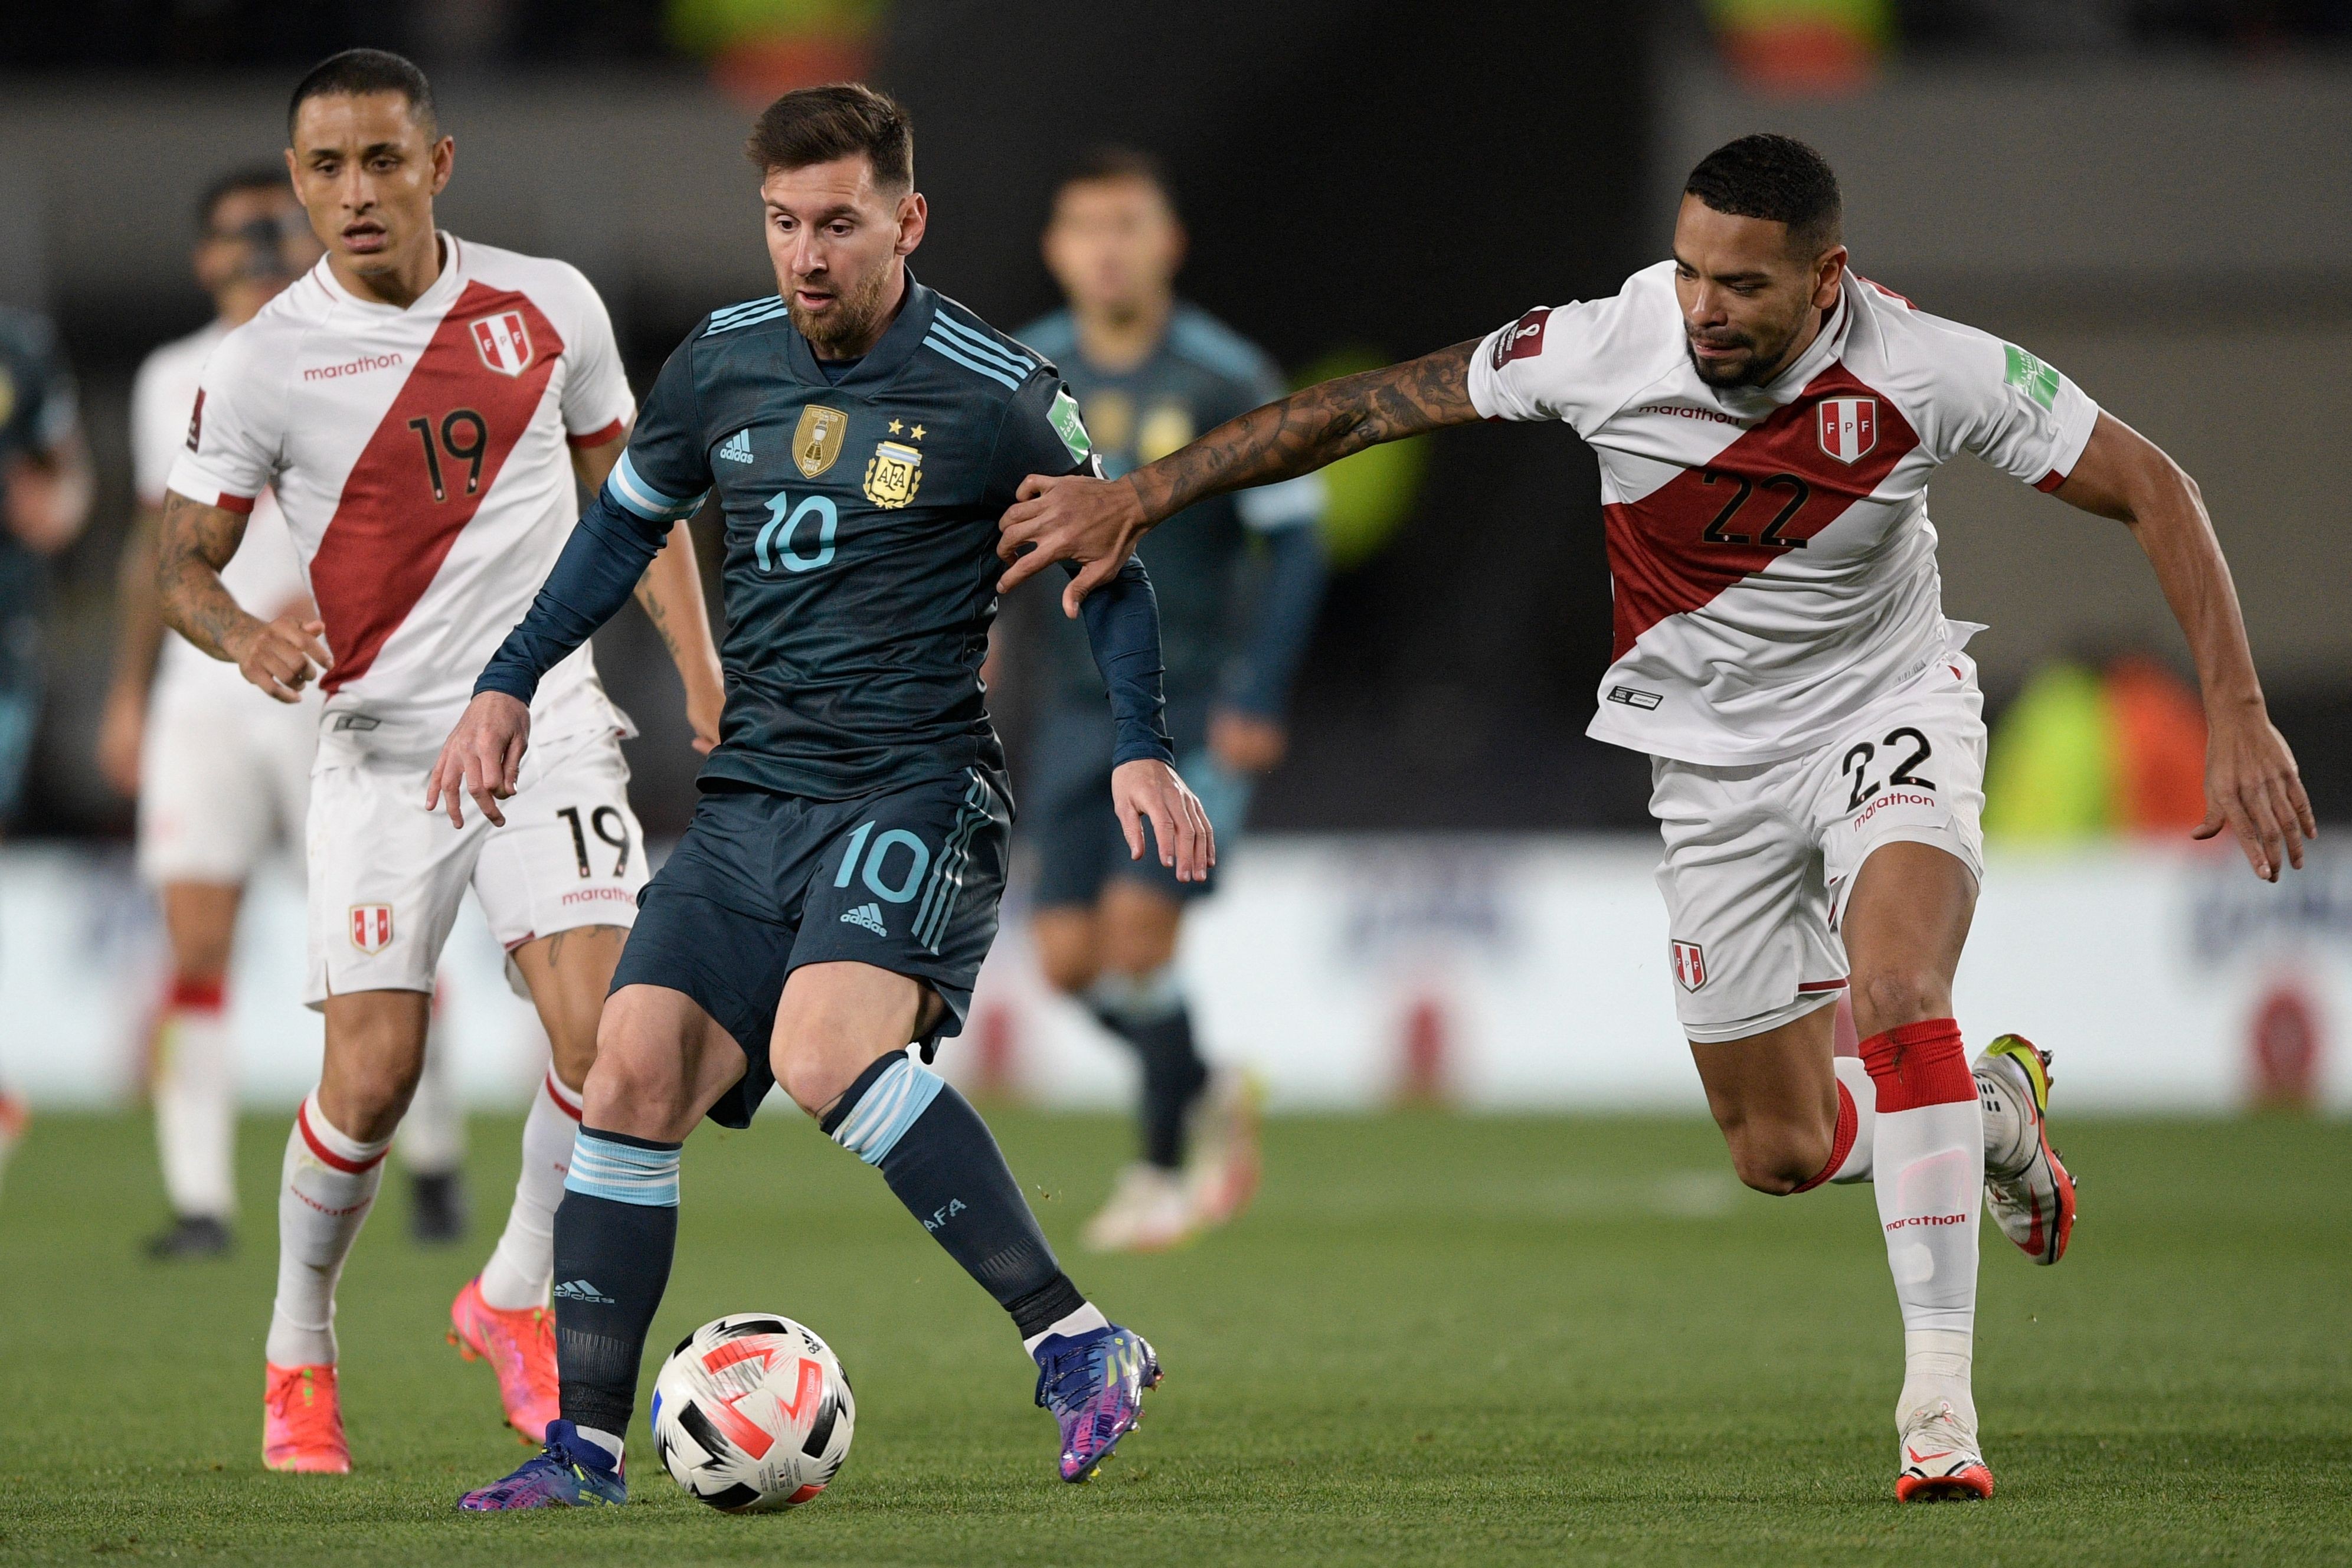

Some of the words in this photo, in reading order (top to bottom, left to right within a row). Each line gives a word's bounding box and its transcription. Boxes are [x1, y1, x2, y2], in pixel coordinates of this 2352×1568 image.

[303, 353, 403, 381] marathon
[1638, 405, 1740, 425] marathon
[407, 408, 488, 503] 19
[719, 447, 754, 464] adidas
[876, 459, 905, 491] AFA
[1702, 470, 1810, 549] 22
[755, 490, 838, 572] 10
[1842, 726, 1936, 815] 22
[1854, 793, 1935, 832] marathon
[557, 805, 630, 879] 19
[833, 820, 929, 904] 10
[562, 887, 636, 906] maratho
[840, 914, 888, 938] adidas
[923, 1198, 967, 1232] AFA
[1886, 1213, 1966, 1233] marathon
